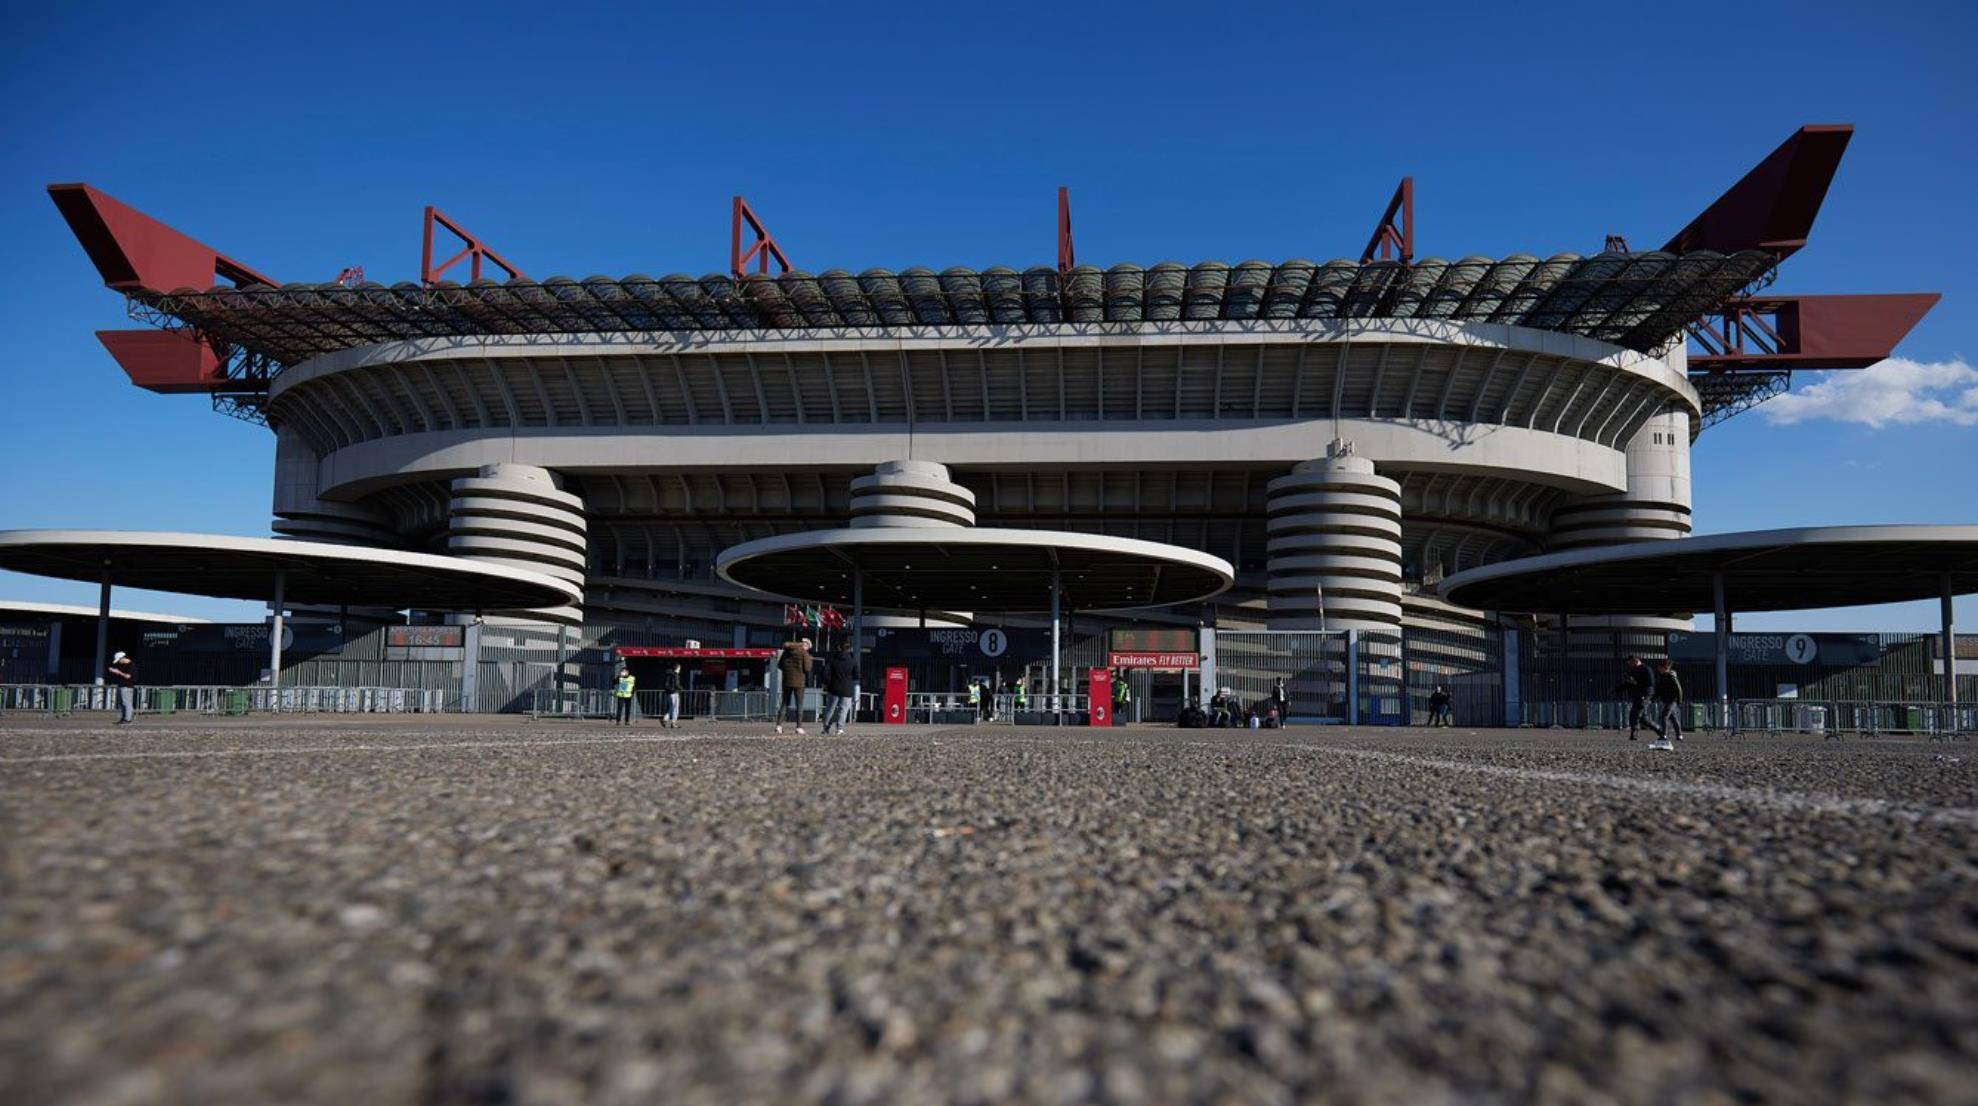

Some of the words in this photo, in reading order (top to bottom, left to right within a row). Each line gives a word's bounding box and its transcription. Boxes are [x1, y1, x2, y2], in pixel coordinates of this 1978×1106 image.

[930, 630, 978, 643] INGRESSO
[988, 632, 998, 653] 8
[1729, 636, 1783, 649] INGRESSO
[943, 643, 965, 654] GATE
[1743, 649, 1769, 661] GATE
[1796, 638, 1806, 659] 9
[1113, 655, 1157, 665] Emirates
[1170, 655, 1194, 666] BETTER
